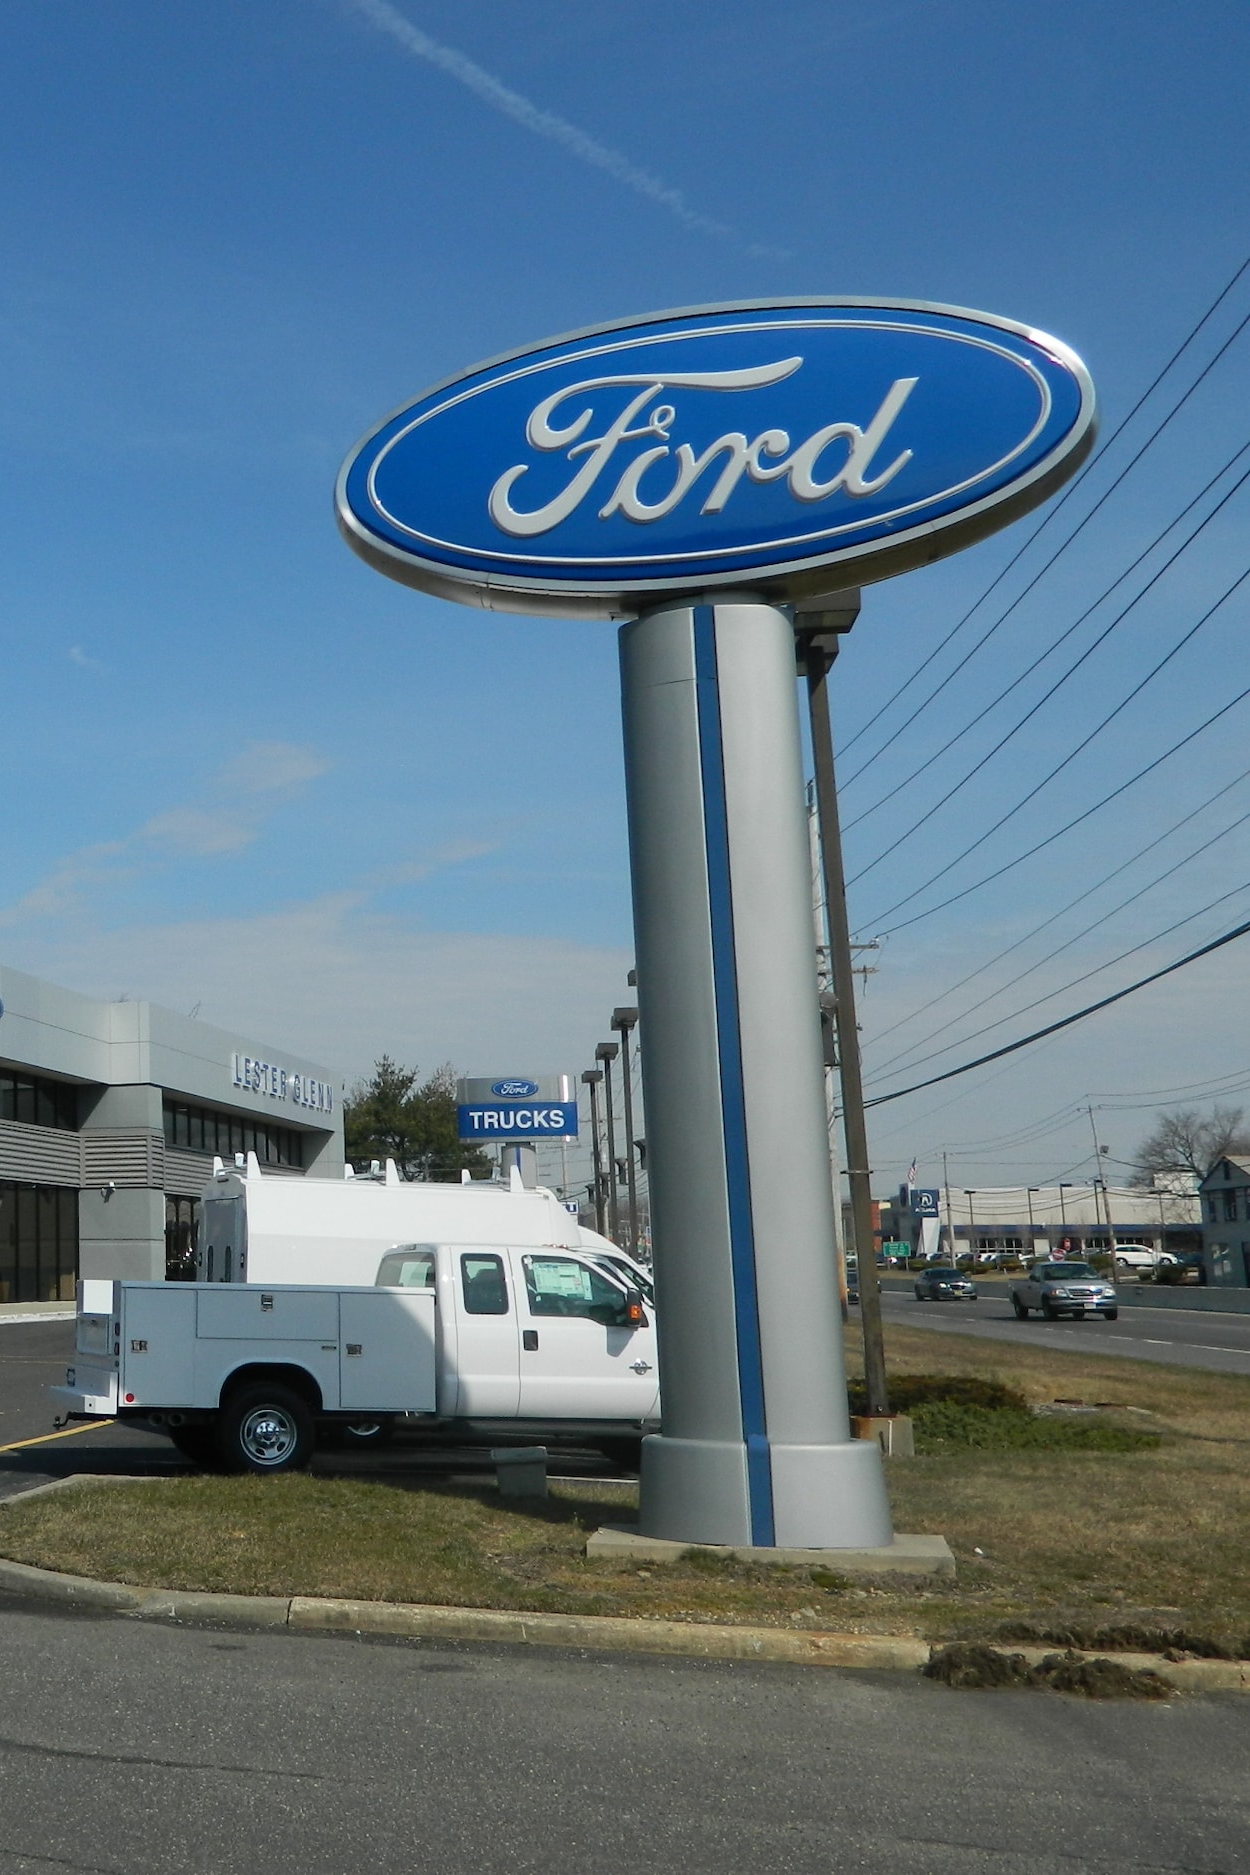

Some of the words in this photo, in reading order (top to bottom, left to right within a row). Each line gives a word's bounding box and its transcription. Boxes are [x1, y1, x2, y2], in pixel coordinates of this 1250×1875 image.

[489, 356, 919, 538] Ford
[232, 1053, 287, 1099] LESTER
[293, 1074, 333, 1112] GLENN
[500, 1082, 529, 1095] Ford
[469, 1109, 565, 1130] TRUCKS
